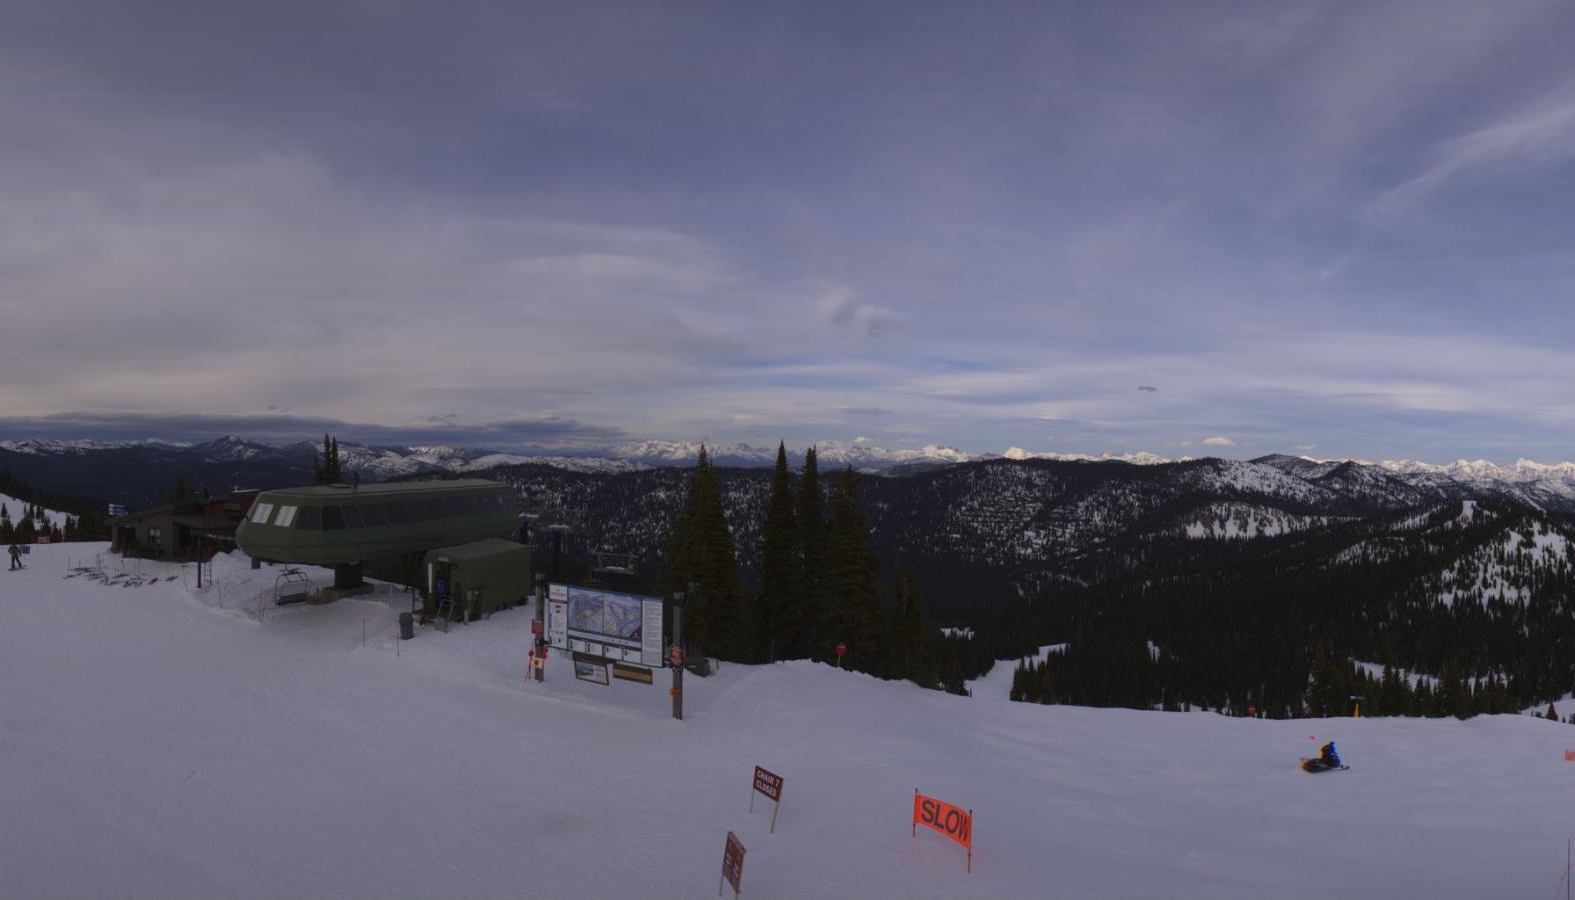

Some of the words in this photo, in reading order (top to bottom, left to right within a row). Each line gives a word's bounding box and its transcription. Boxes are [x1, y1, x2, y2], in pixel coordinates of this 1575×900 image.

[756, 769, 775, 785] CHAIR
[775, 779, 781, 788] 7
[756, 779, 777, 797] CLOSED
[921, 800, 967, 842] SLOW
